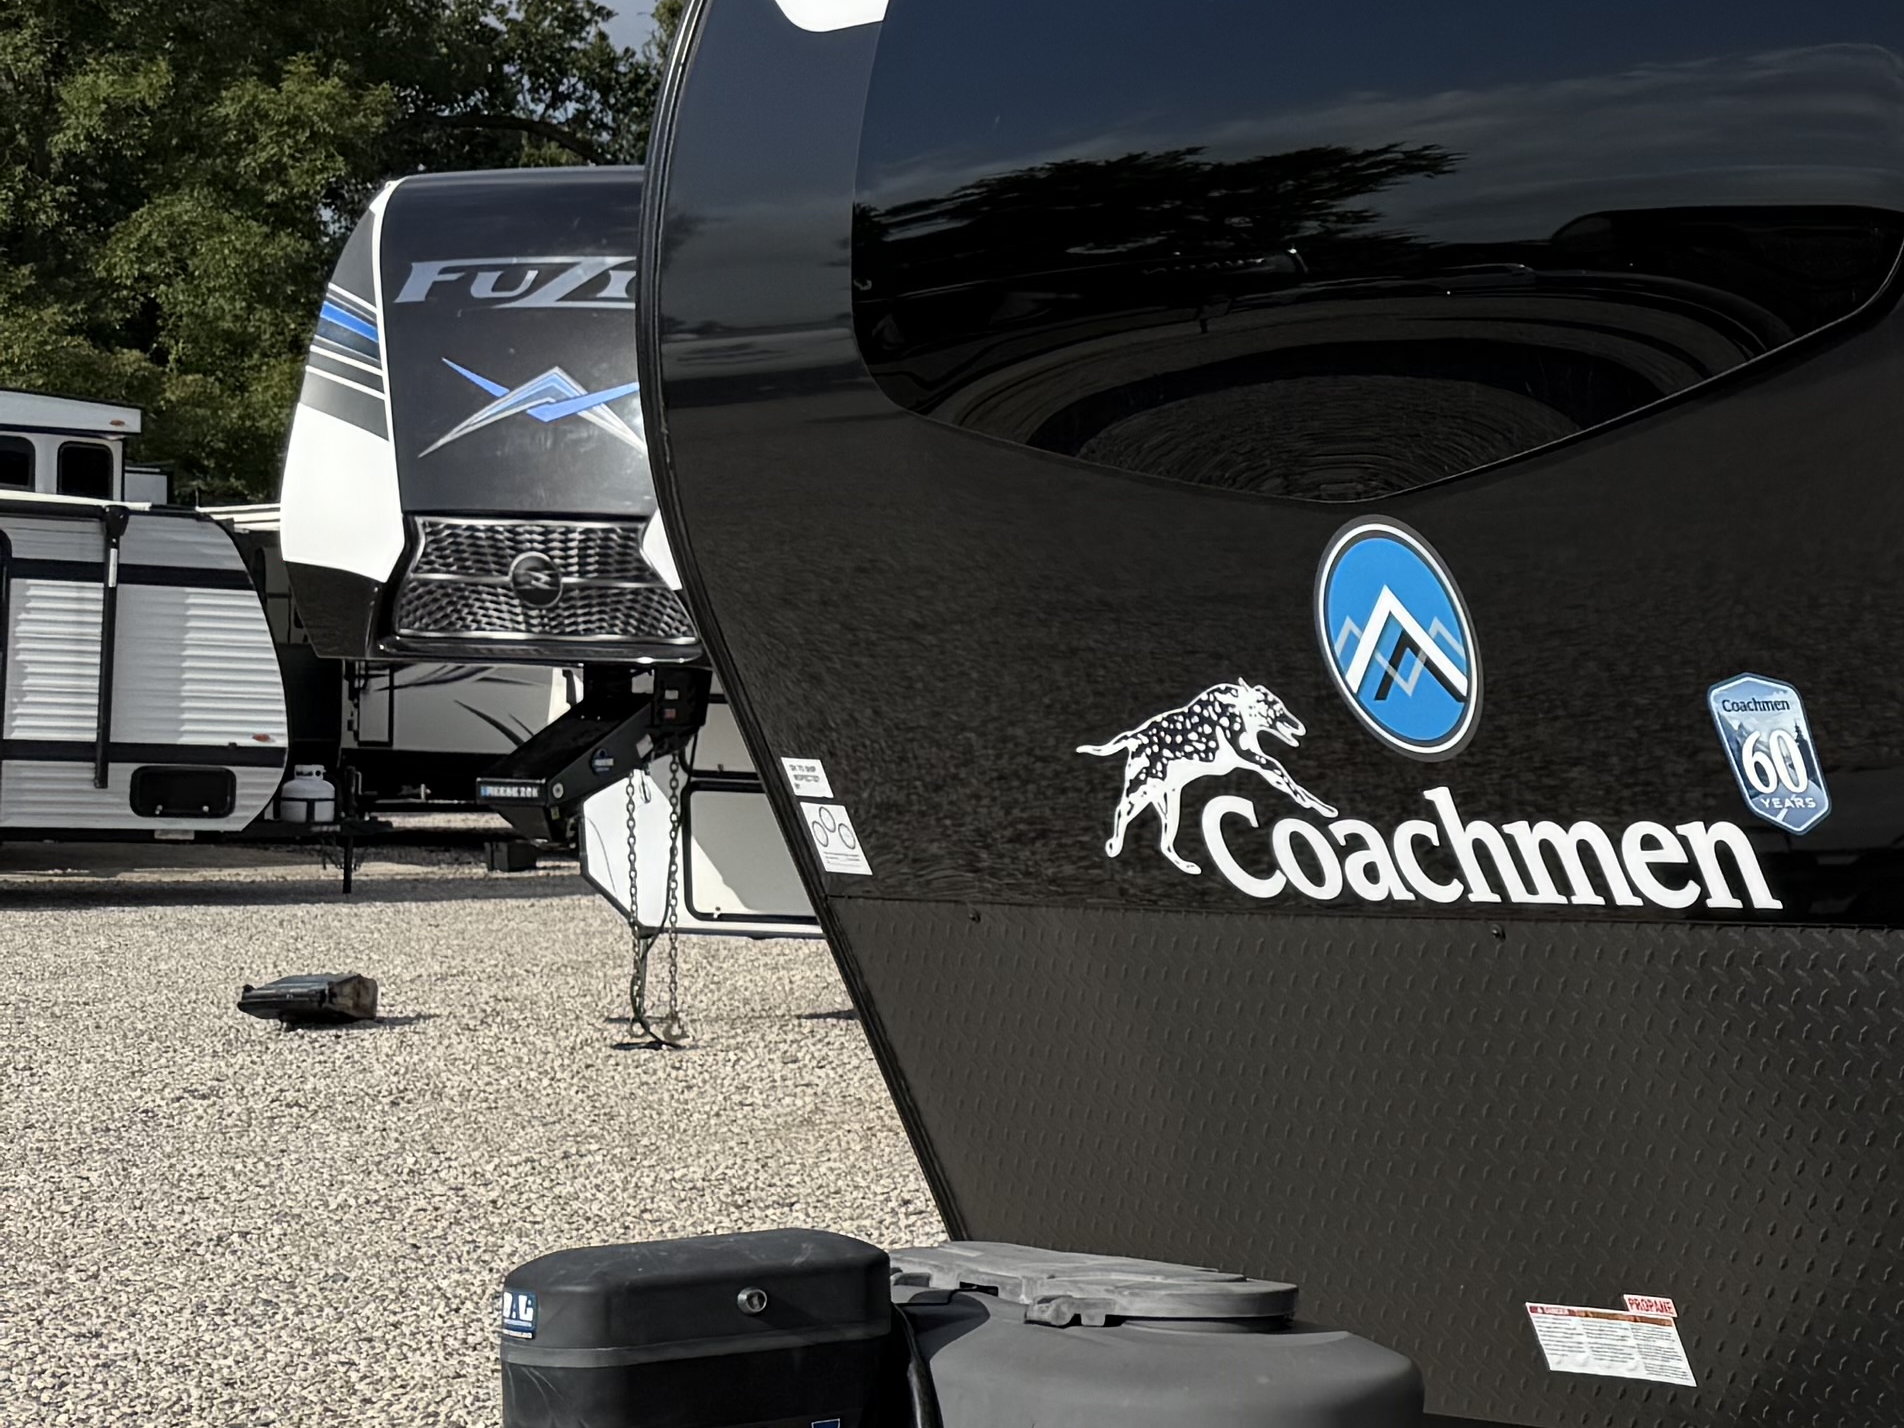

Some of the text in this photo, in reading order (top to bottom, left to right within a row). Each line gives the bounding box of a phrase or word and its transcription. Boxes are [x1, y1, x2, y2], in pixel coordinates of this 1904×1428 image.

[393, 255, 637, 309] FUZI
[1721, 697, 1791, 713] Coachmen
[1741, 729, 1808, 795] 60
[1759, 795, 1817, 809] YEARS
[1200, 786, 1783, 910] Coachmen
[1627, 1297, 1675, 1314] PROPANE
